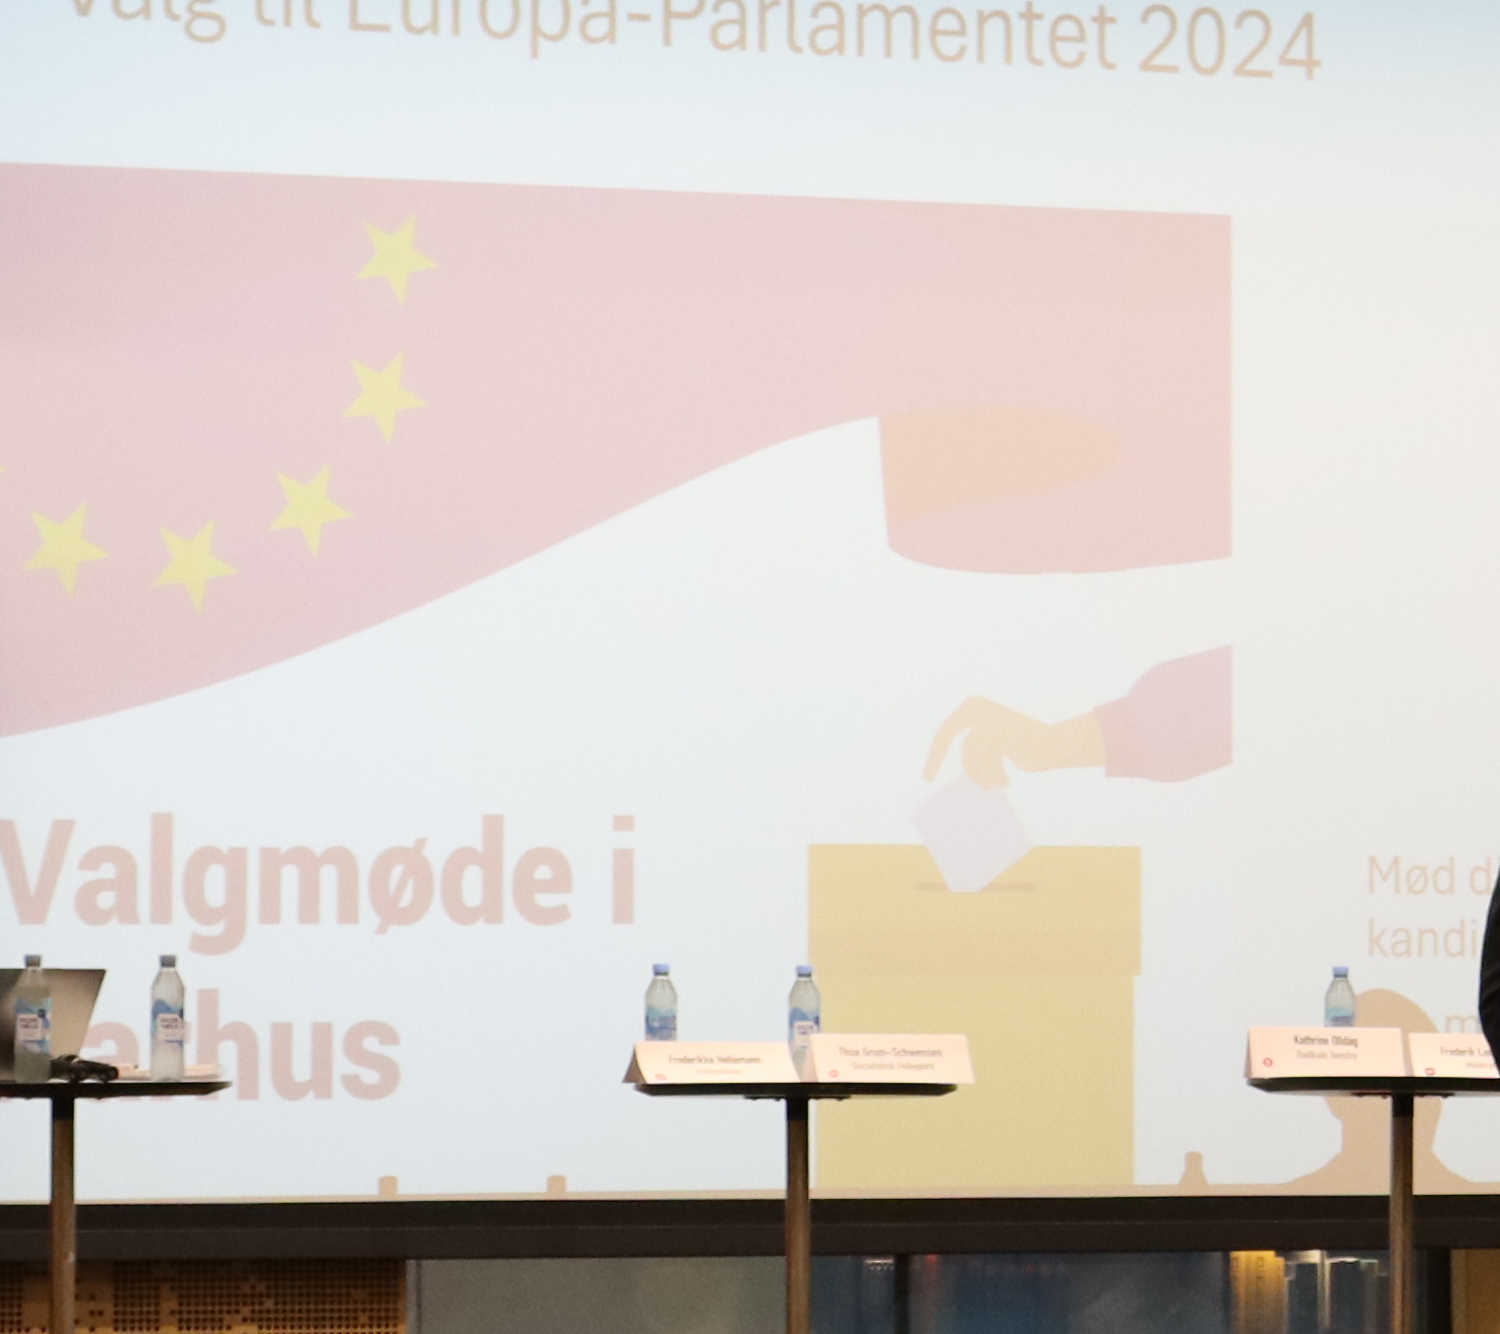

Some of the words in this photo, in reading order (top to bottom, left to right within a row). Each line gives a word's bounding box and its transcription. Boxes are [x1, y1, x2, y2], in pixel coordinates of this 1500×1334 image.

[1137, 4, 1322, 82] 2024
[611, 815, 636, 925] i
[1368, 855, 1454, 895] Mød
[1368, 918, 1478, 958] kandi
